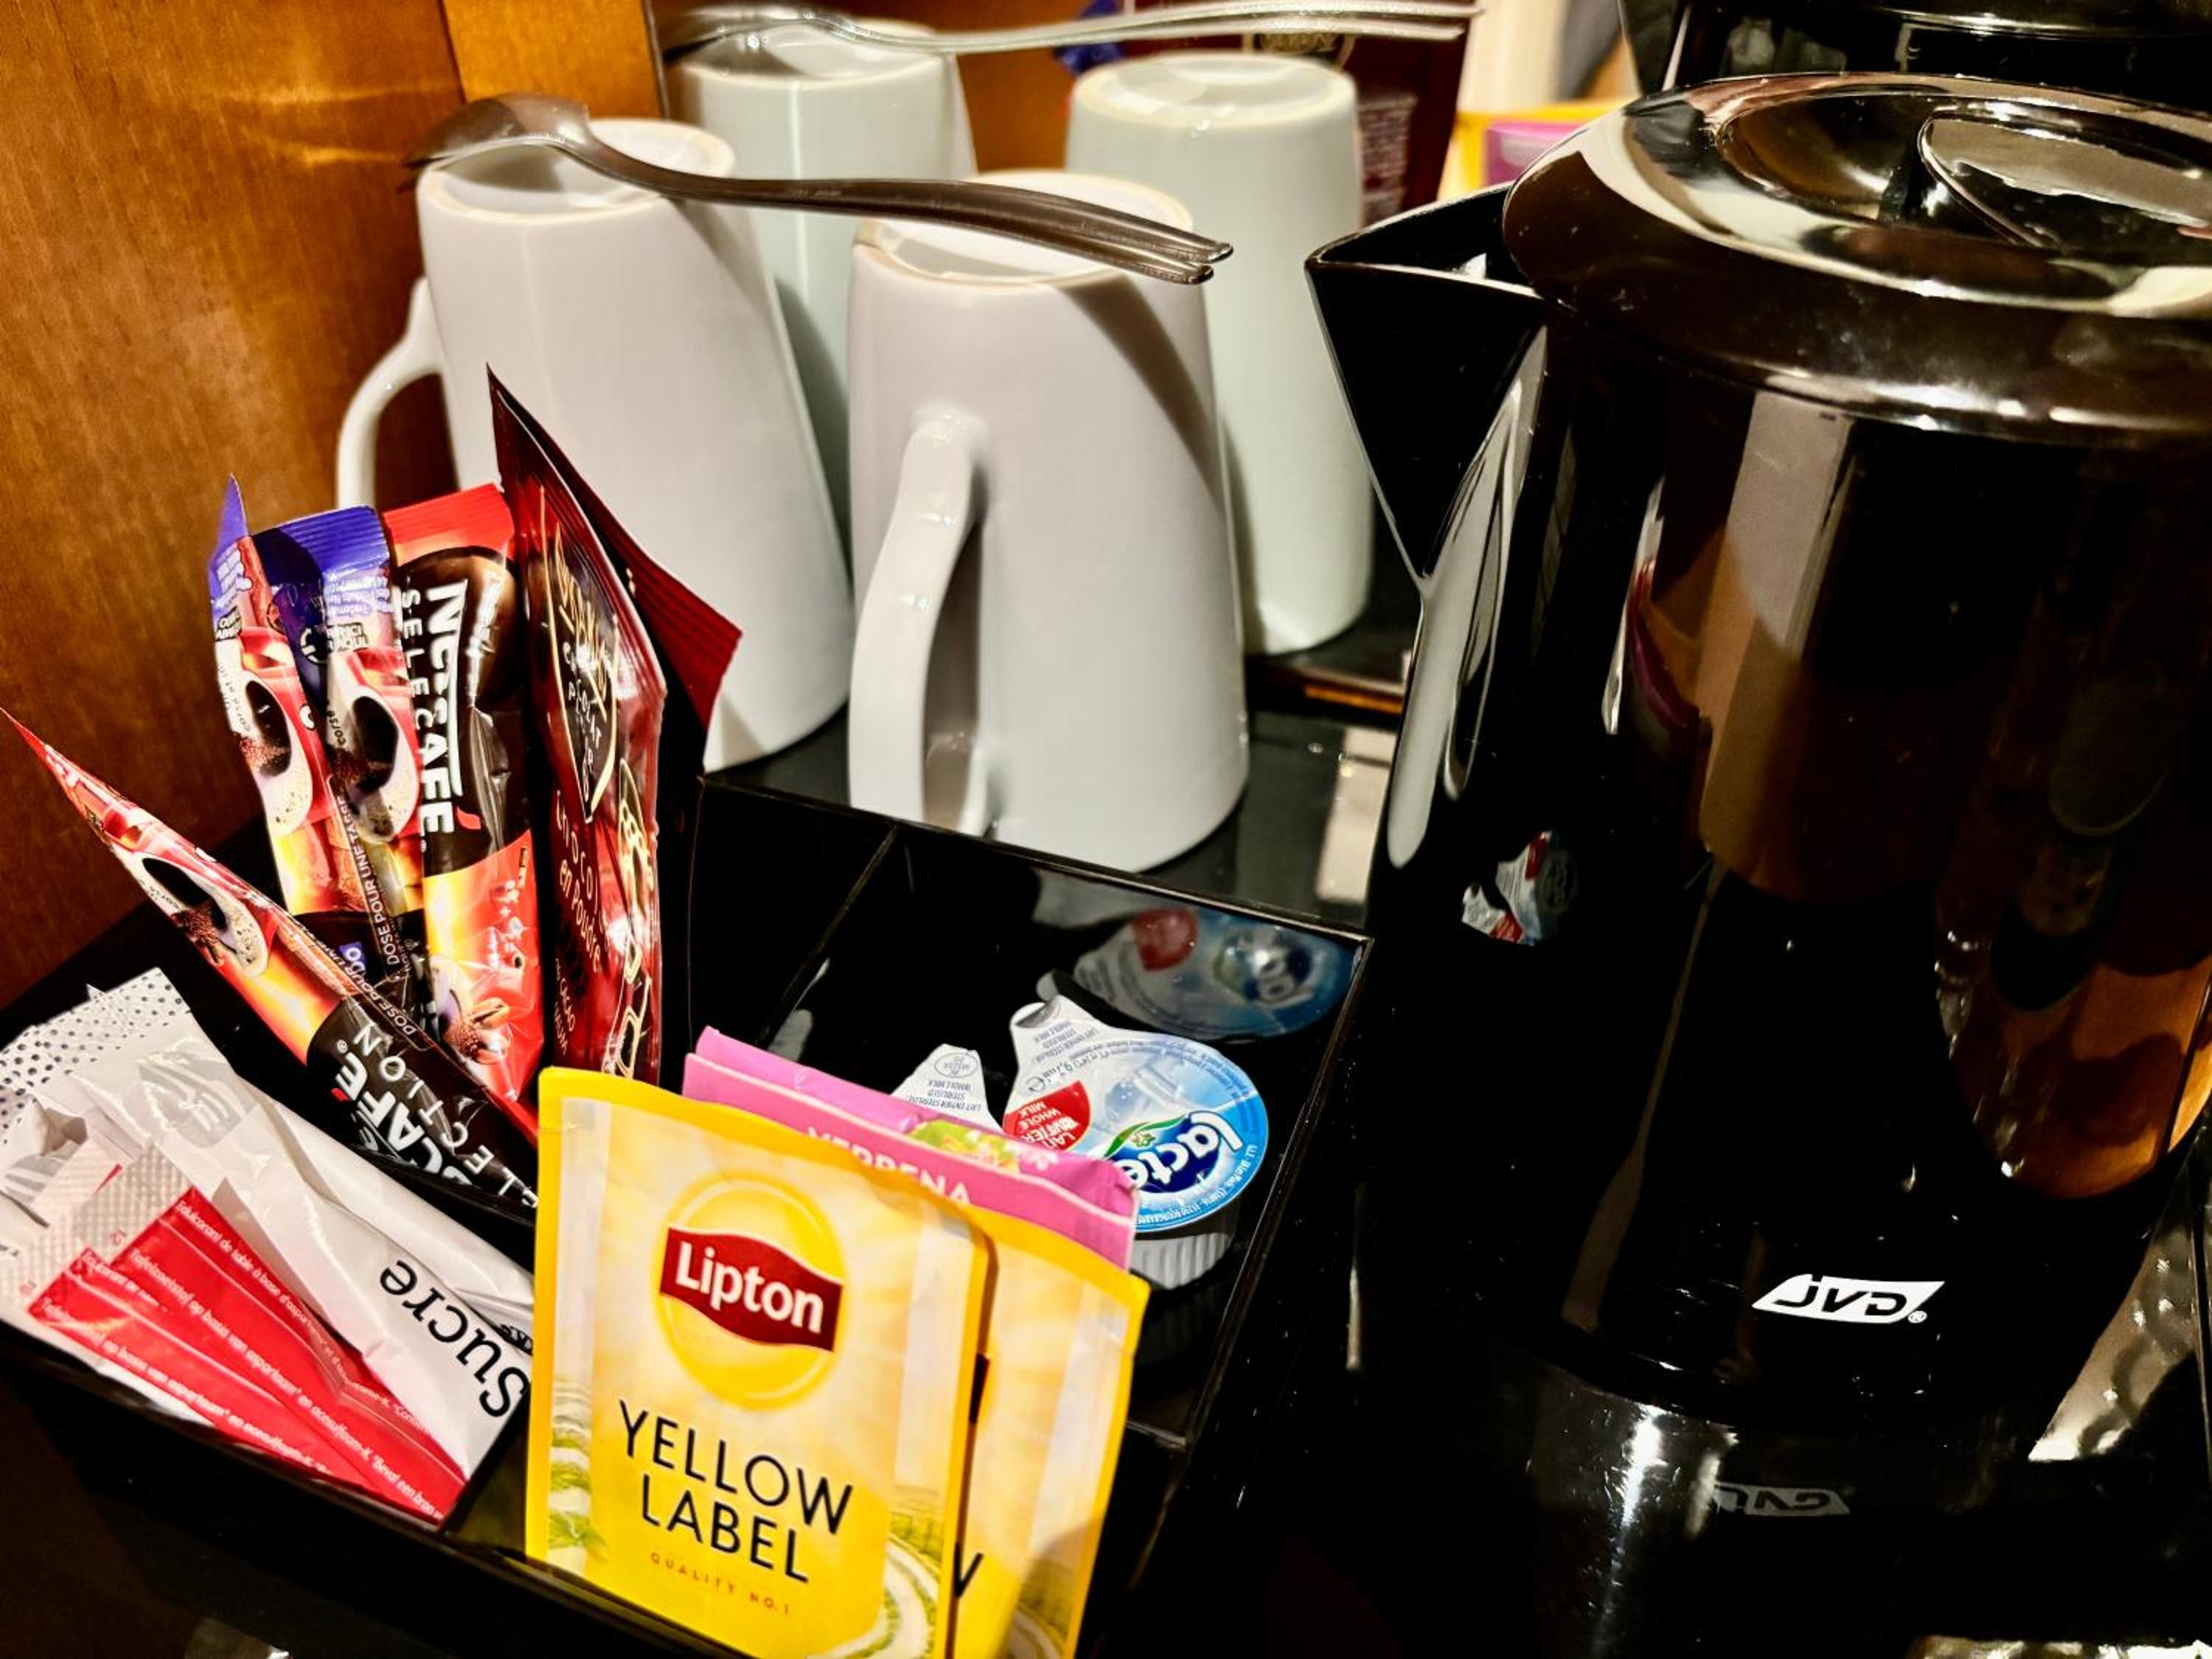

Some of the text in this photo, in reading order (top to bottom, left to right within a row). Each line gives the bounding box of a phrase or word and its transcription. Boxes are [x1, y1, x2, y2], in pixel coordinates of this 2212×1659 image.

[400, 589, 434, 726] SELEC
[354, 844, 373, 877] UNE
[363, 877, 387, 923] POUR
[376, 922, 400, 966] DOSE
[378, 998, 417, 1037] DOSE
[331, 1051, 472, 1186] CAFÉ
[354, 1020, 540, 1209] LECTION
[1017, 1101, 1046, 1119] MILK
[1018, 1107, 1061, 1130] WHOLE
[1112, 1113, 1245, 1192] lacte
[676, 1242, 824, 1332] Lipton
[379, 1259, 530, 1419] Sucre
[619, 1400, 853, 1535] YELLOW
[641, 1475, 810, 1584] LABEL
[650, 1552, 736, 1593] QUALITY
